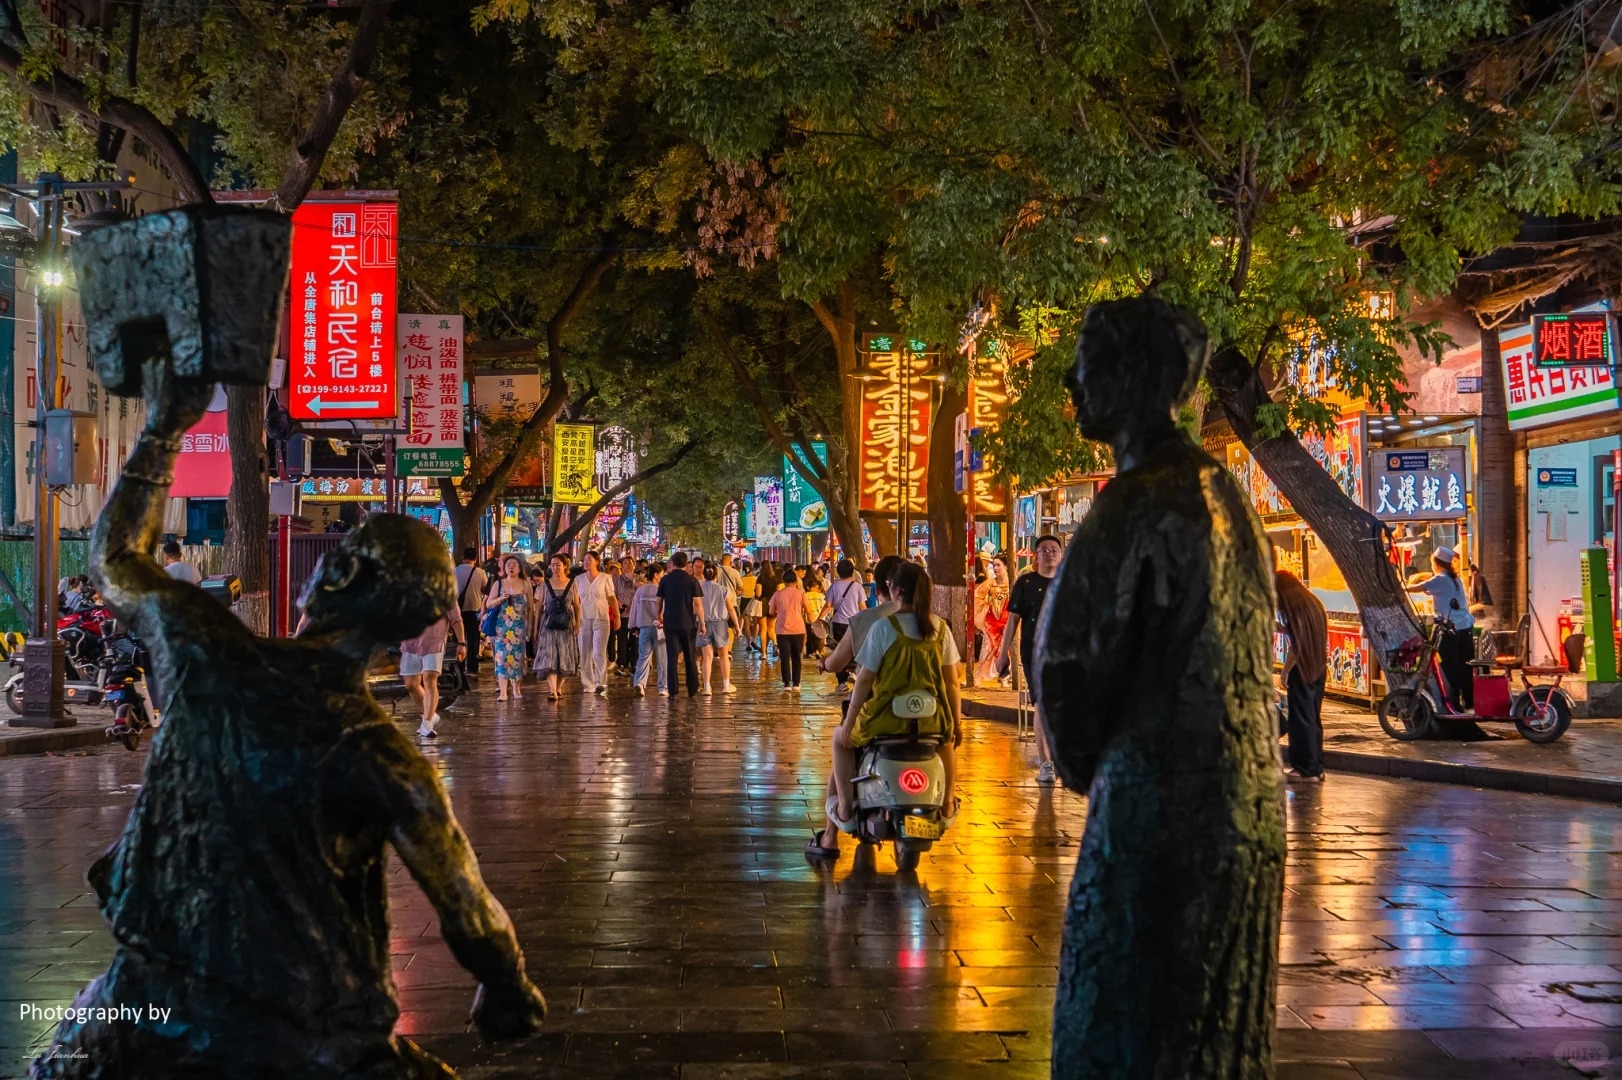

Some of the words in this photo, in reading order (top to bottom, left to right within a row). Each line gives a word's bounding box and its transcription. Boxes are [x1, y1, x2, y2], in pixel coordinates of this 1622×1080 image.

[370, 293, 383, 378] 前台请上5楼
[409, 319, 451, 330] 清真
[440, 337, 458, 369] 油泼面
[1540, 321, 1604, 361] 烟酒
[440, 373, 458, 405] 裤带面
[440, 409, 459, 441] 菠菜面
[418, 460, 460, 468] 68878555
[1376, 473, 1464, 515] 火爆鱿鱼
